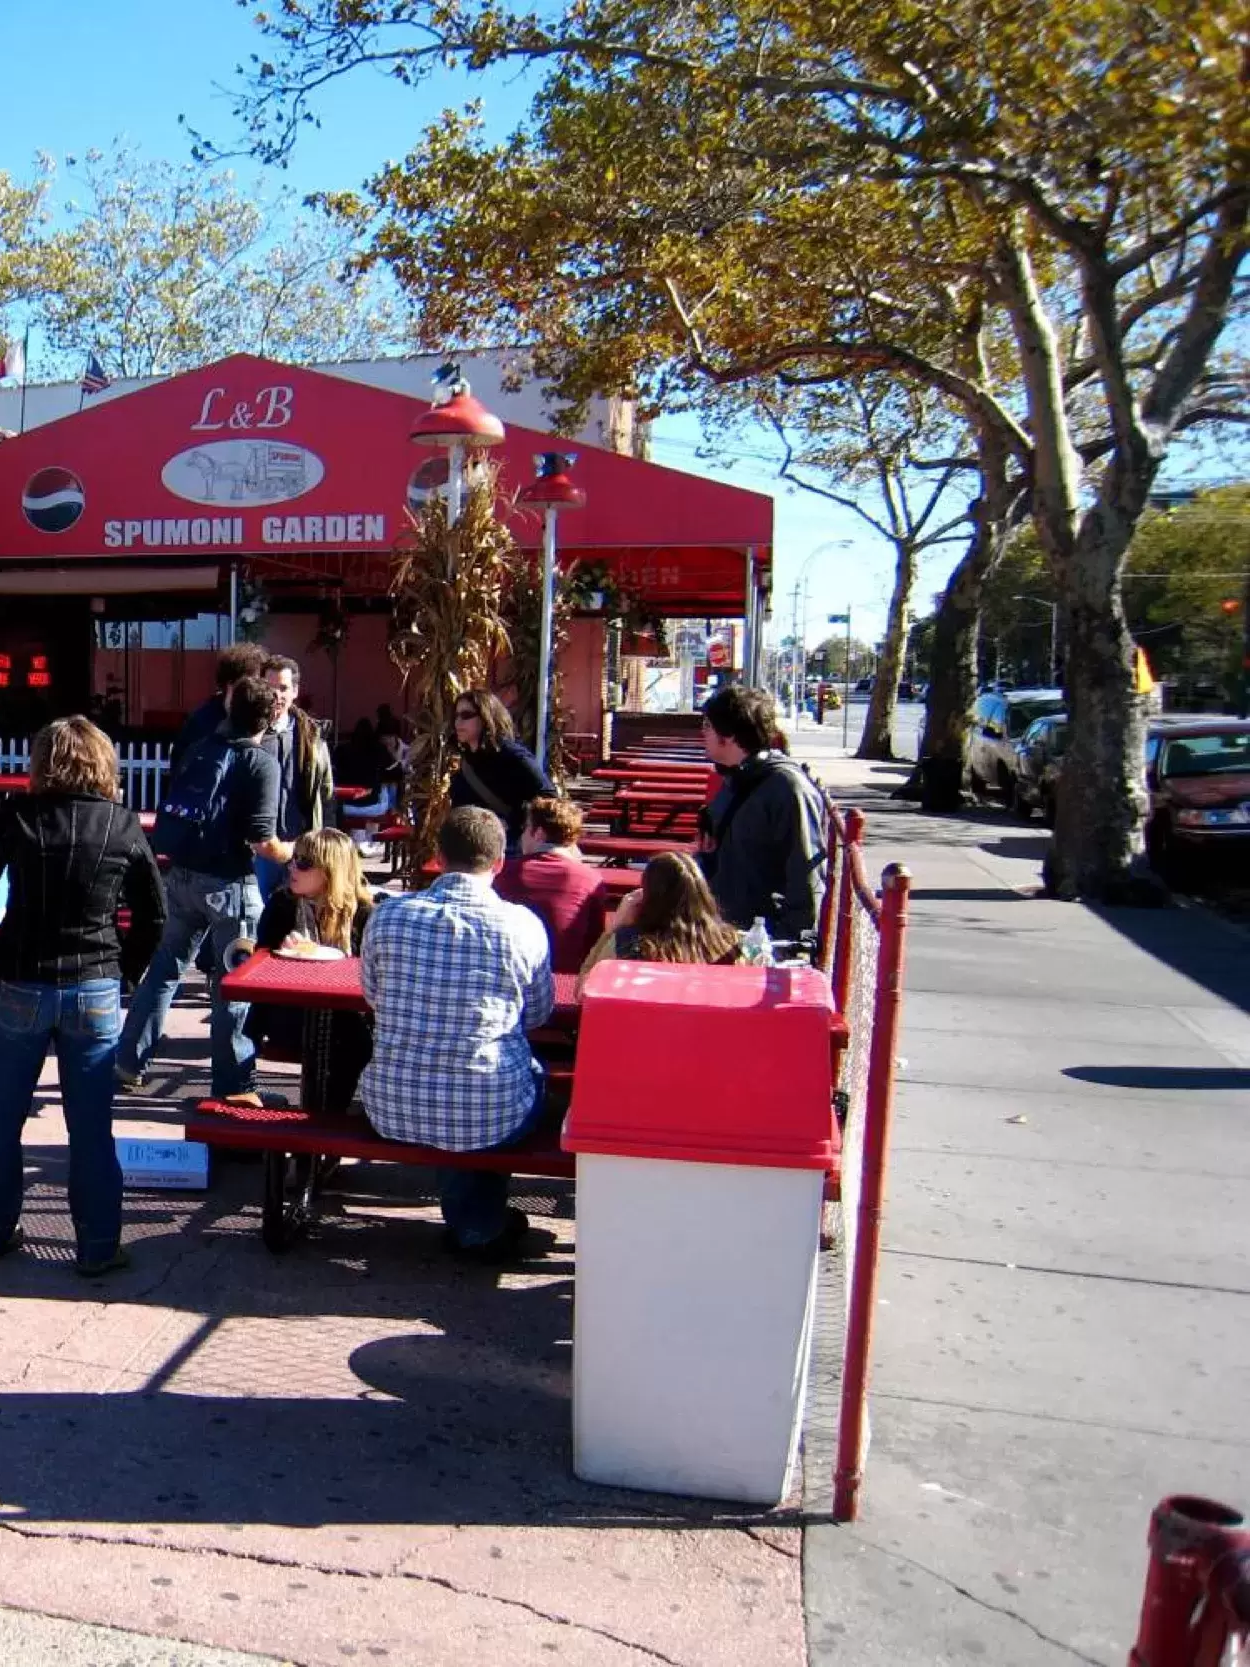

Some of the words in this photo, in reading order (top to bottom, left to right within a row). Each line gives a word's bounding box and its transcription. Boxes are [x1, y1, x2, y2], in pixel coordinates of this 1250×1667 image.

[190, 386, 294, 430] L&B
[104, 517, 243, 547] SPUMONI
[262, 515, 384, 543] GARDEN
